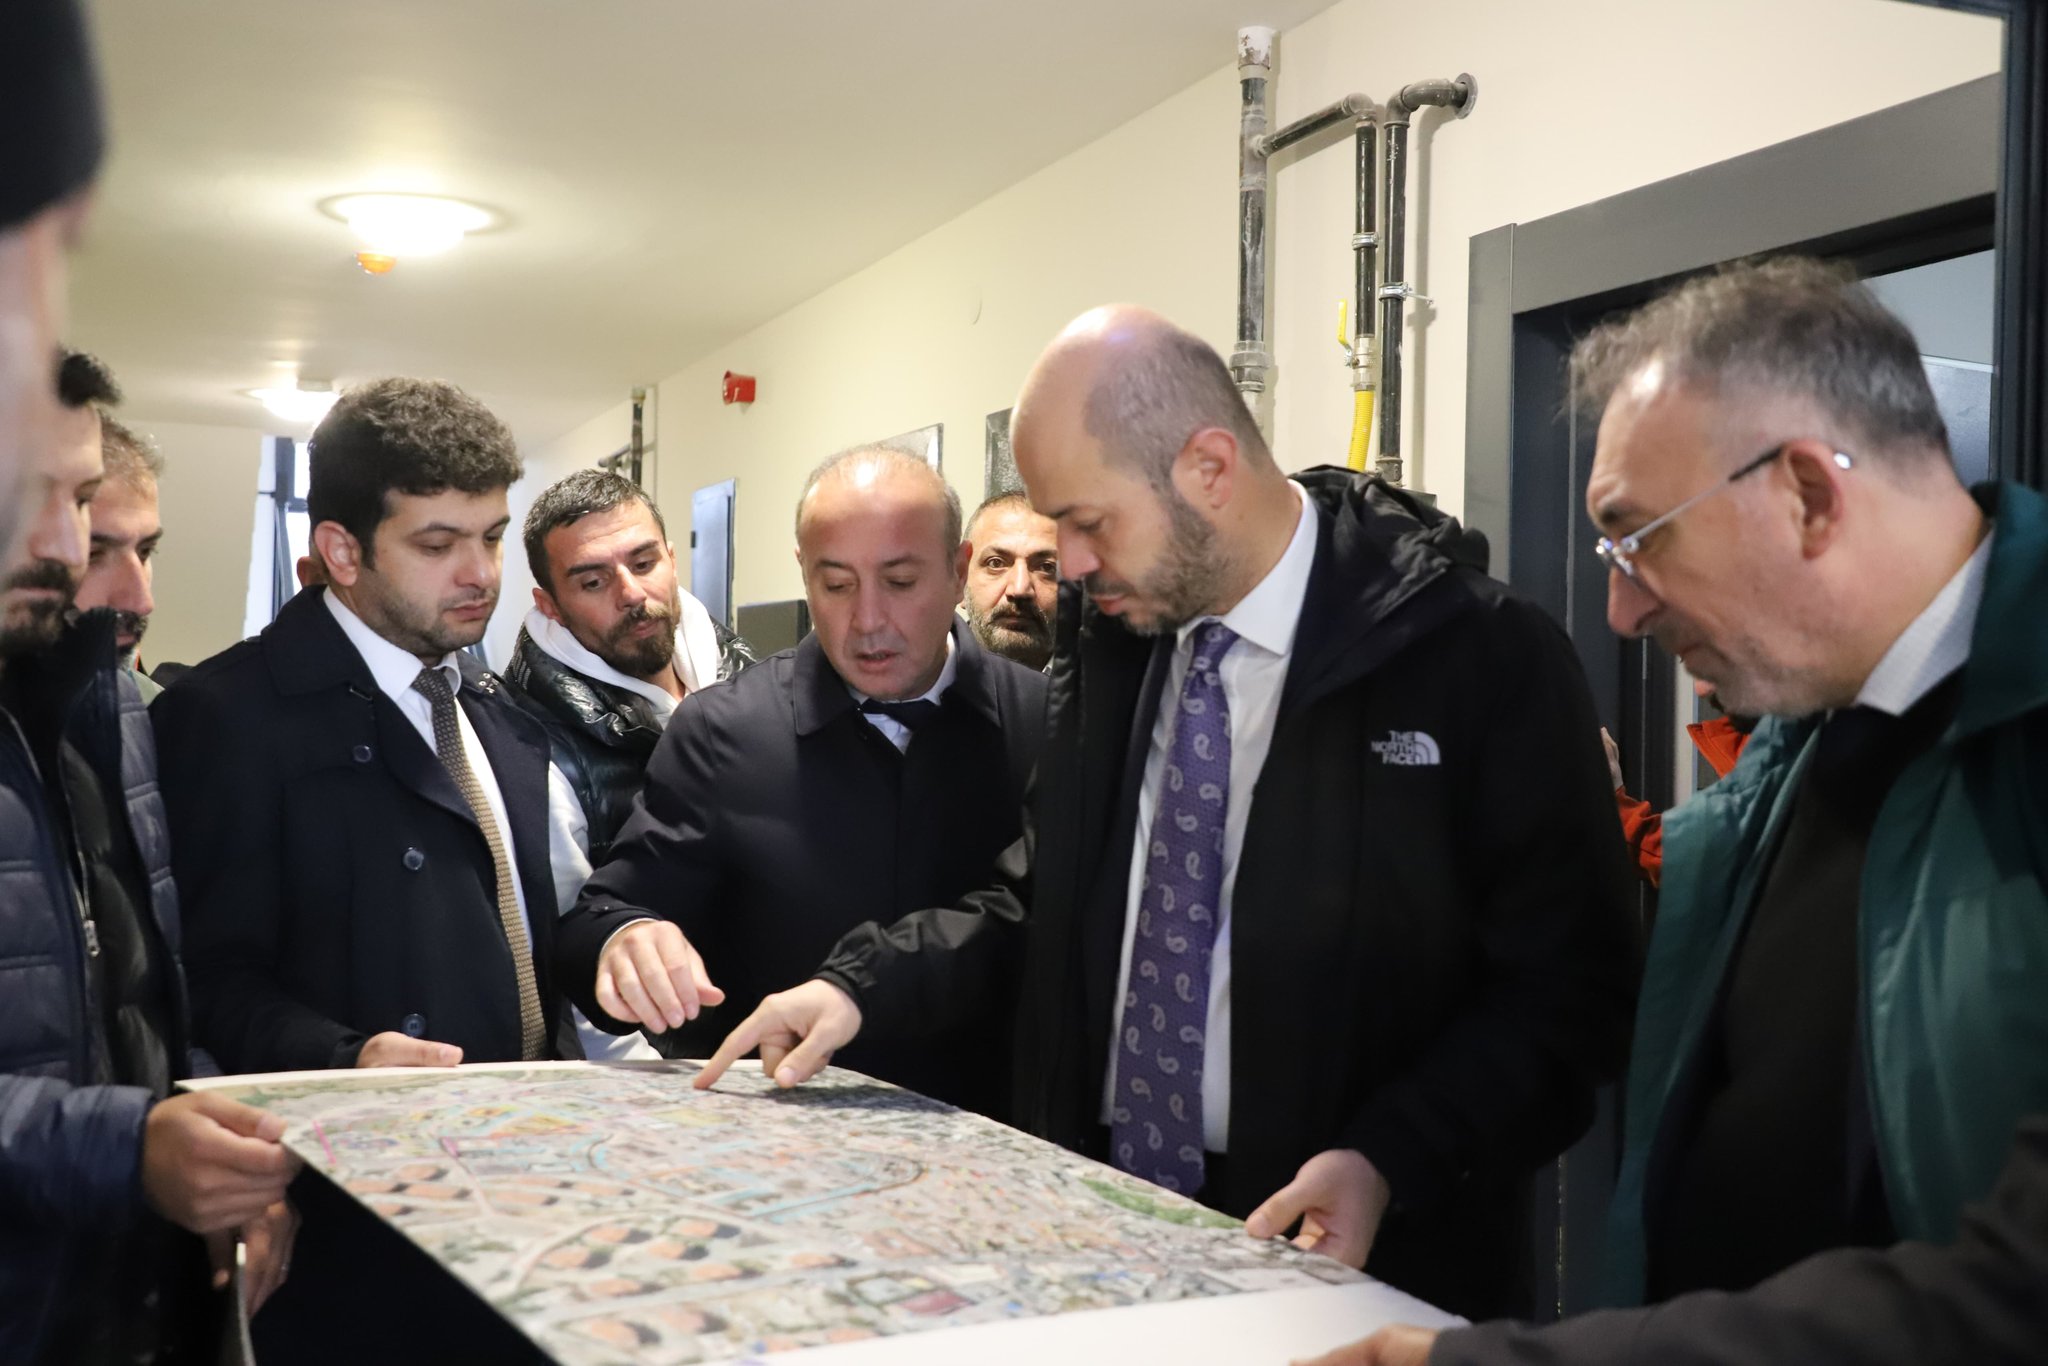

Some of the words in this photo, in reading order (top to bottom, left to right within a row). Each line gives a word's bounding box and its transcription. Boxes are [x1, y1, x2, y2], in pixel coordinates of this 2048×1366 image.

[1388, 730, 1414, 742] THE
[1371, 741, 1414, 753] NORTH
[1382, 752, 1414, 765] FACE
